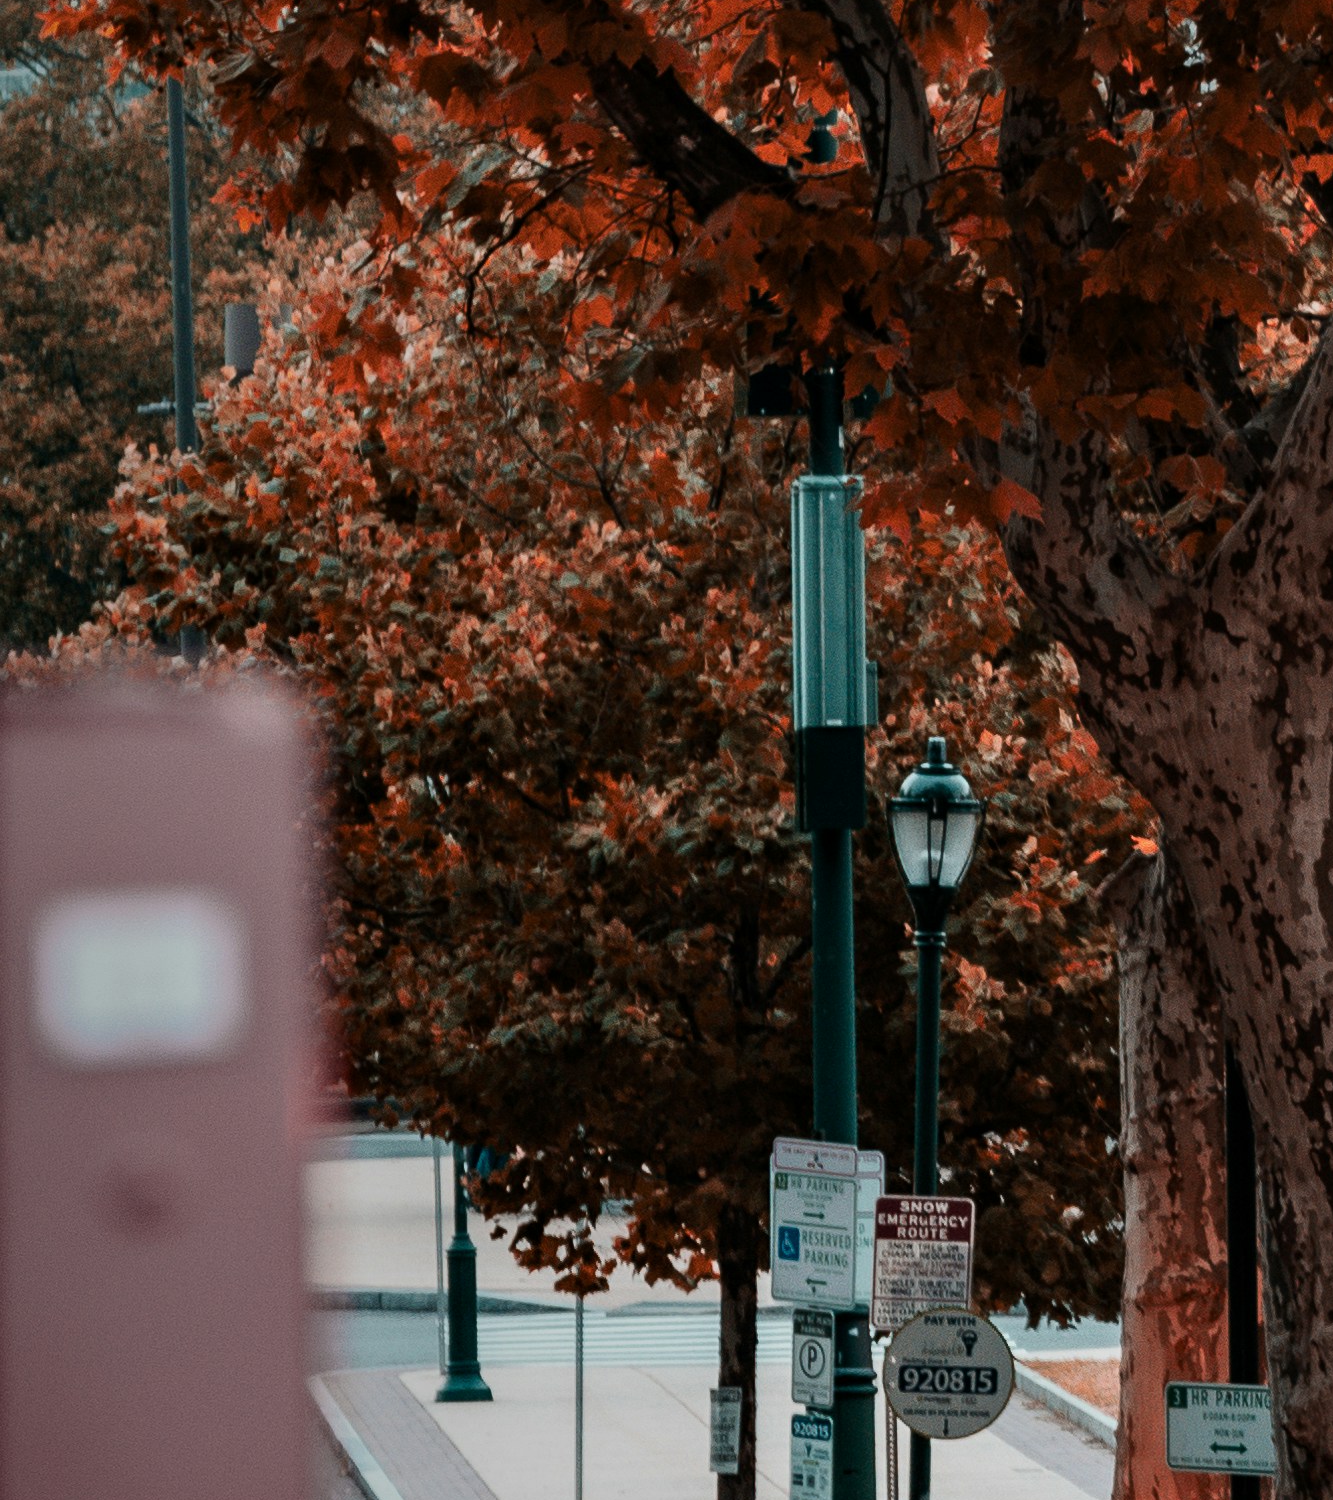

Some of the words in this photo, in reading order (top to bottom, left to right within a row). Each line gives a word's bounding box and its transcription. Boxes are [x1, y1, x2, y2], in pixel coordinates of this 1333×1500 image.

[899, 1200, 949, 1214] SNOW
[877, 1212, 969, 1228] EMERGENCY
[801, 1229, 852, 1249] RESERVED
[896, 1226, 949, 1240] ROUTE
[803, 1248, 849, 1268] PARKING
[924, 1315, 945, 1326] PAY
[947, 1316, 977, 1326] WITH
[808, 1345, 817, 1371] P
[903, 1367, 993, 1393] 920815
[1173, 1389, 1180, 1406] 3
[1191, 1389, 1209, 1406] HR
[1215, 1390, 1271, 1410] PARKING
